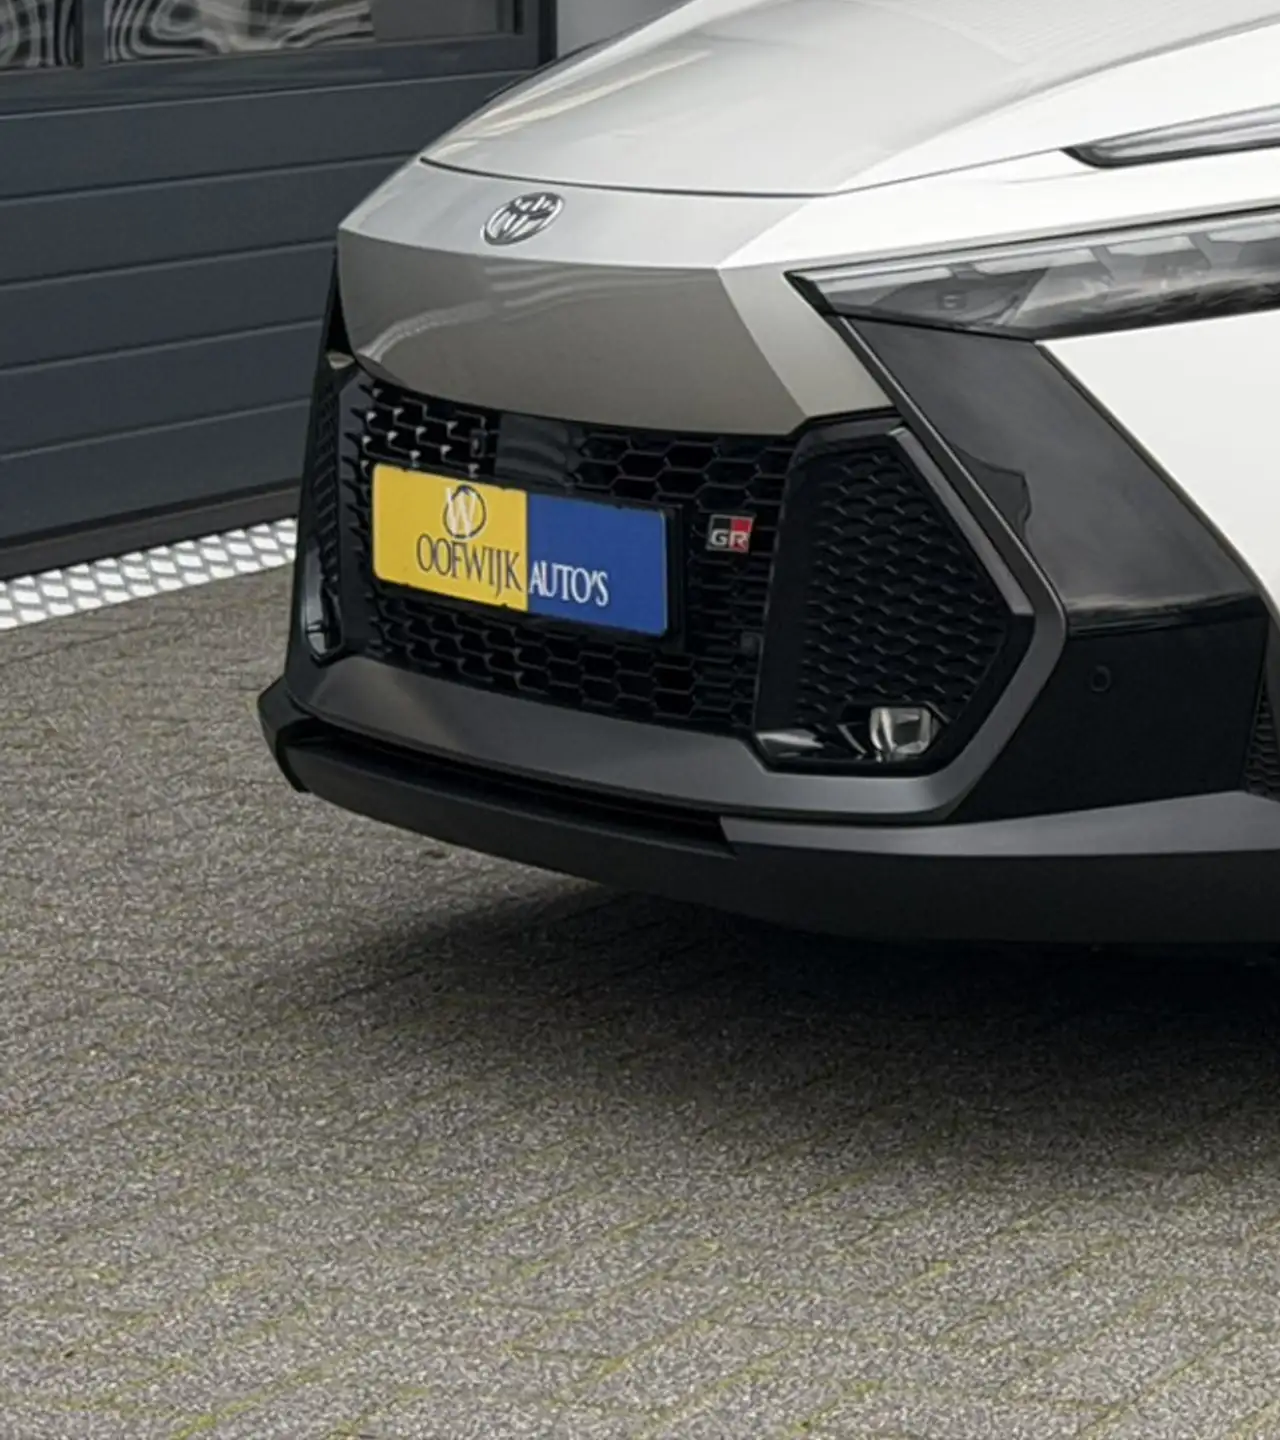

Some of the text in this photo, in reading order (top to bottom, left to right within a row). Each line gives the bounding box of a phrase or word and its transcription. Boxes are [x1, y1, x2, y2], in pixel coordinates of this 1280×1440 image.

[711, 529, 749, 550] GR
[416, 533, 609, 606] OOFWIJK AUTO'S
